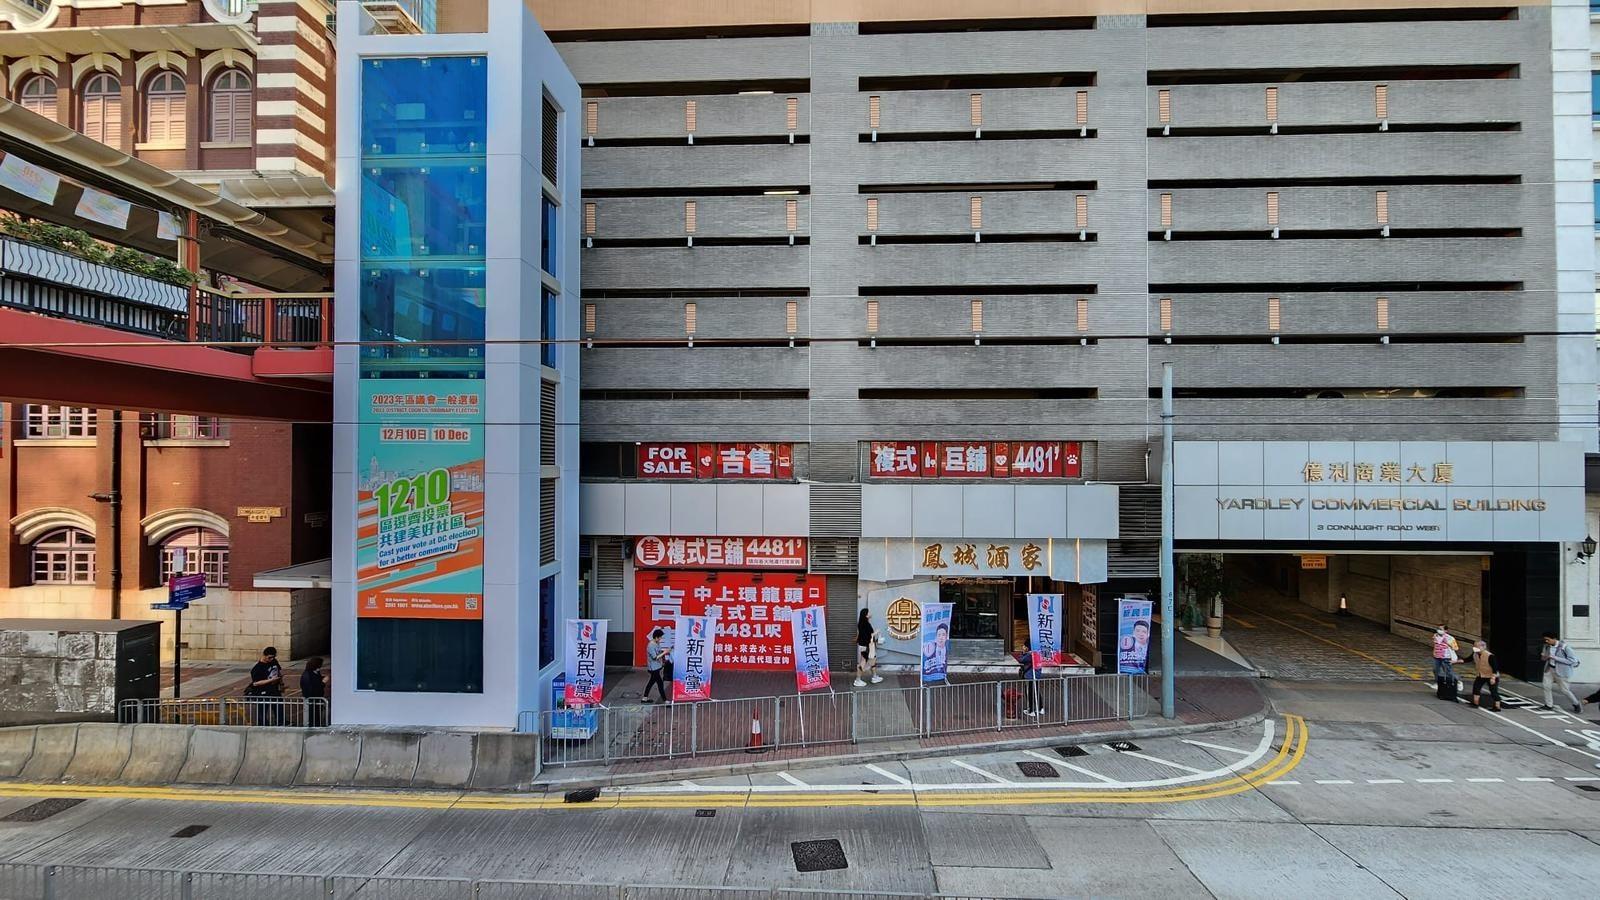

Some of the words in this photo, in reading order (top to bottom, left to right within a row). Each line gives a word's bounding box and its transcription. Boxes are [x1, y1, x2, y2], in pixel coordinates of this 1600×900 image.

[382, 428, 427, 440] 12月10日
[433, 429, 445, 440] 10
[447, 429, 468, 440] Dec
[643, 461, 692, 474] SALE
[648, 447, 687, 460] FOR
[720, 447, 772, 474] 吉售
[874, 446, 917, 473] 複式
[945, 446, 987, 473] 巨舖
[1301, 461, 1455, 484] 億利商業大廈
[374, 468, 449, 518] 1210
[1216, 498, 1305, 511] YARDLEY
[1311, 498, 1447, 512] COMMERCIAL
[1453, 498, 1547, 512] BUILDING
[380, 504, 449, 534] 區選齊投票
[380, 515, 463, 548] 共建美好社區
[379, 547, 394, 558] Cast
[396, 545, 411, 556] your
[412, 540, 427, 549] vote
[428, 537, 436, 546] at
[437, 535, 447, 543] DC
[448, 528, 476, 541] election
[379, 558, 389, 567] for
[390, 557, 396, 565] a
[396, 552, 417, 562] better
[418, 542, 457, 557] community
[641, 538, 660, 562] 售
[667, 537, 744, 565] 複式巨舖
[922, 543, 1042, 571] 鳳城酒家
[1037, 613, 1054, 661] 新民黨
[575, 642, 597, 698] 新民黨
[685, 638, 705, 694] 新民黨
[801, 629, 823, 684] 新民黨
